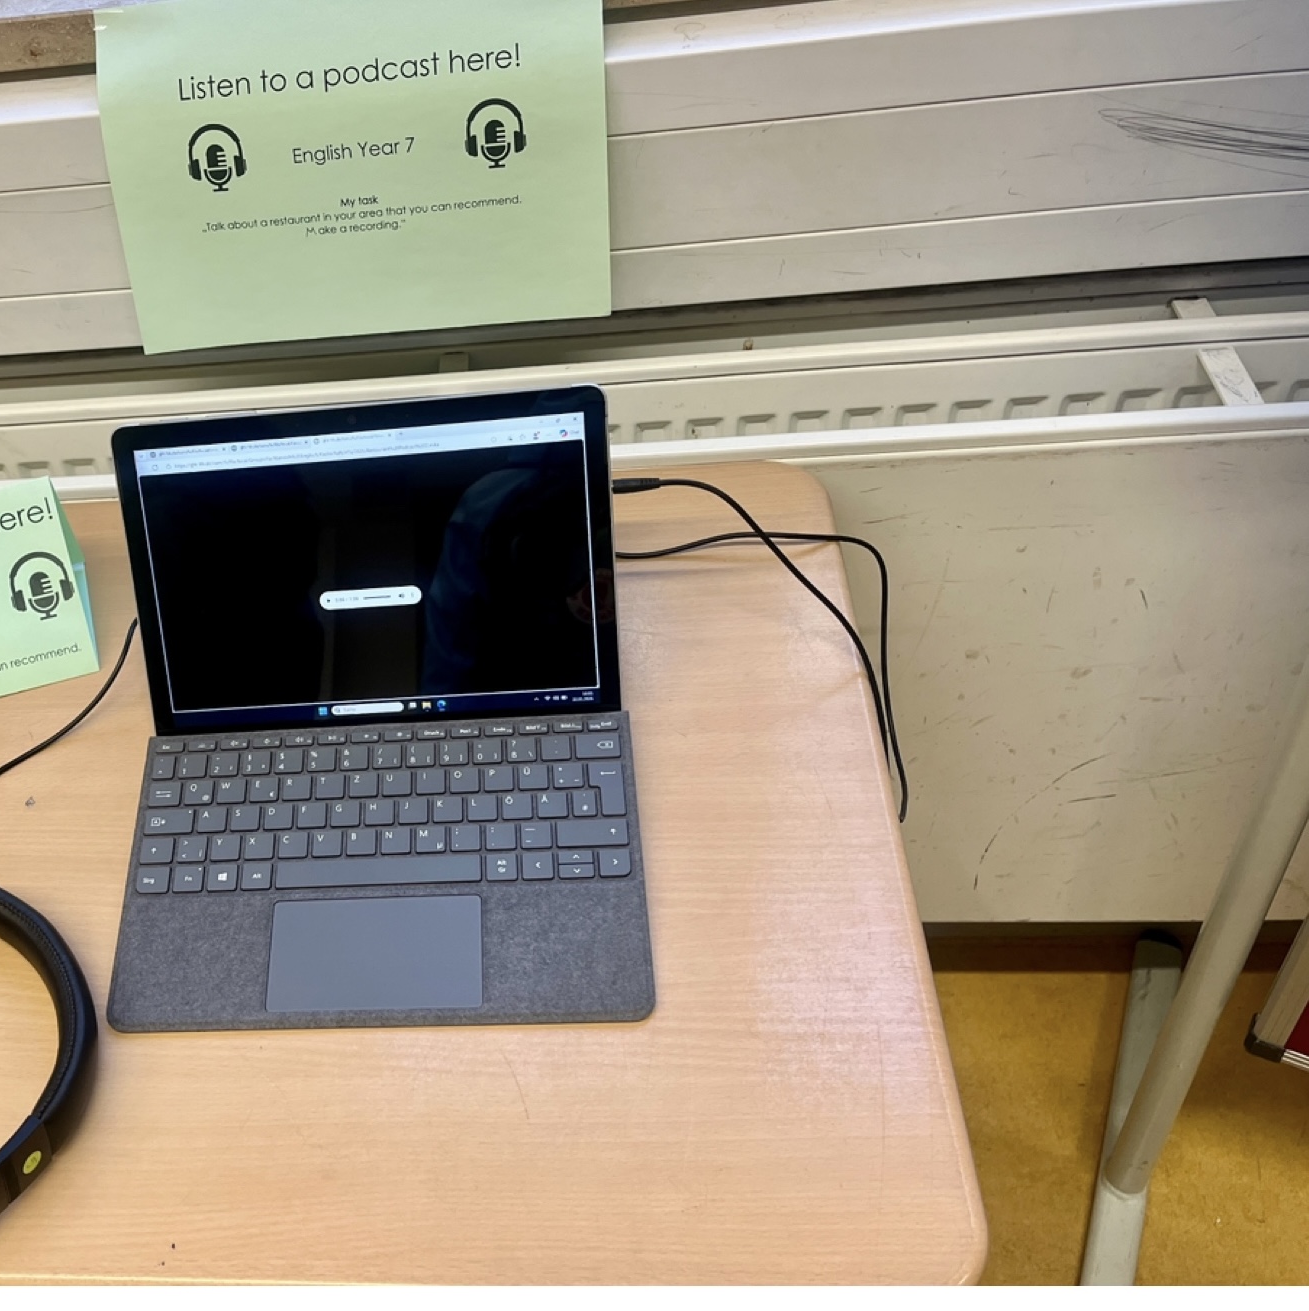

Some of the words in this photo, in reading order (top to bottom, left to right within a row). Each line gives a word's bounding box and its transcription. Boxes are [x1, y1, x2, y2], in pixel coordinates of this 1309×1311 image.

[178, 73, 251, 101] Listen
[261, 68, 287, 94] to
[296, 70, 314, 90] a
[323, 51, 439, 93] podcast
[449, 43, 521, 73] here!
[293, 143, 352, 166] English
[357, 138, 399, 160] Year
[404, 137, 415, 153] 7
[228, 219, 257, 230] about
[260, 219, 268, 227] a
[270, 213, 320, 226] restaurant
[323, 212, 331, 221] in
[333, 211, 356, 223] your
[359, 208, 383, 219] area
[386, 205, 406, 217] that
[409, 205, 427, 216] you
[431, 202, 452, 212] can
[454, 195, 522, 209] recommend.
[340, 197, 356, 207] My
[359, 195, 379, 206] task
[340, 225, 347, 233] a
[10, 642, 82, 669] recommend.
